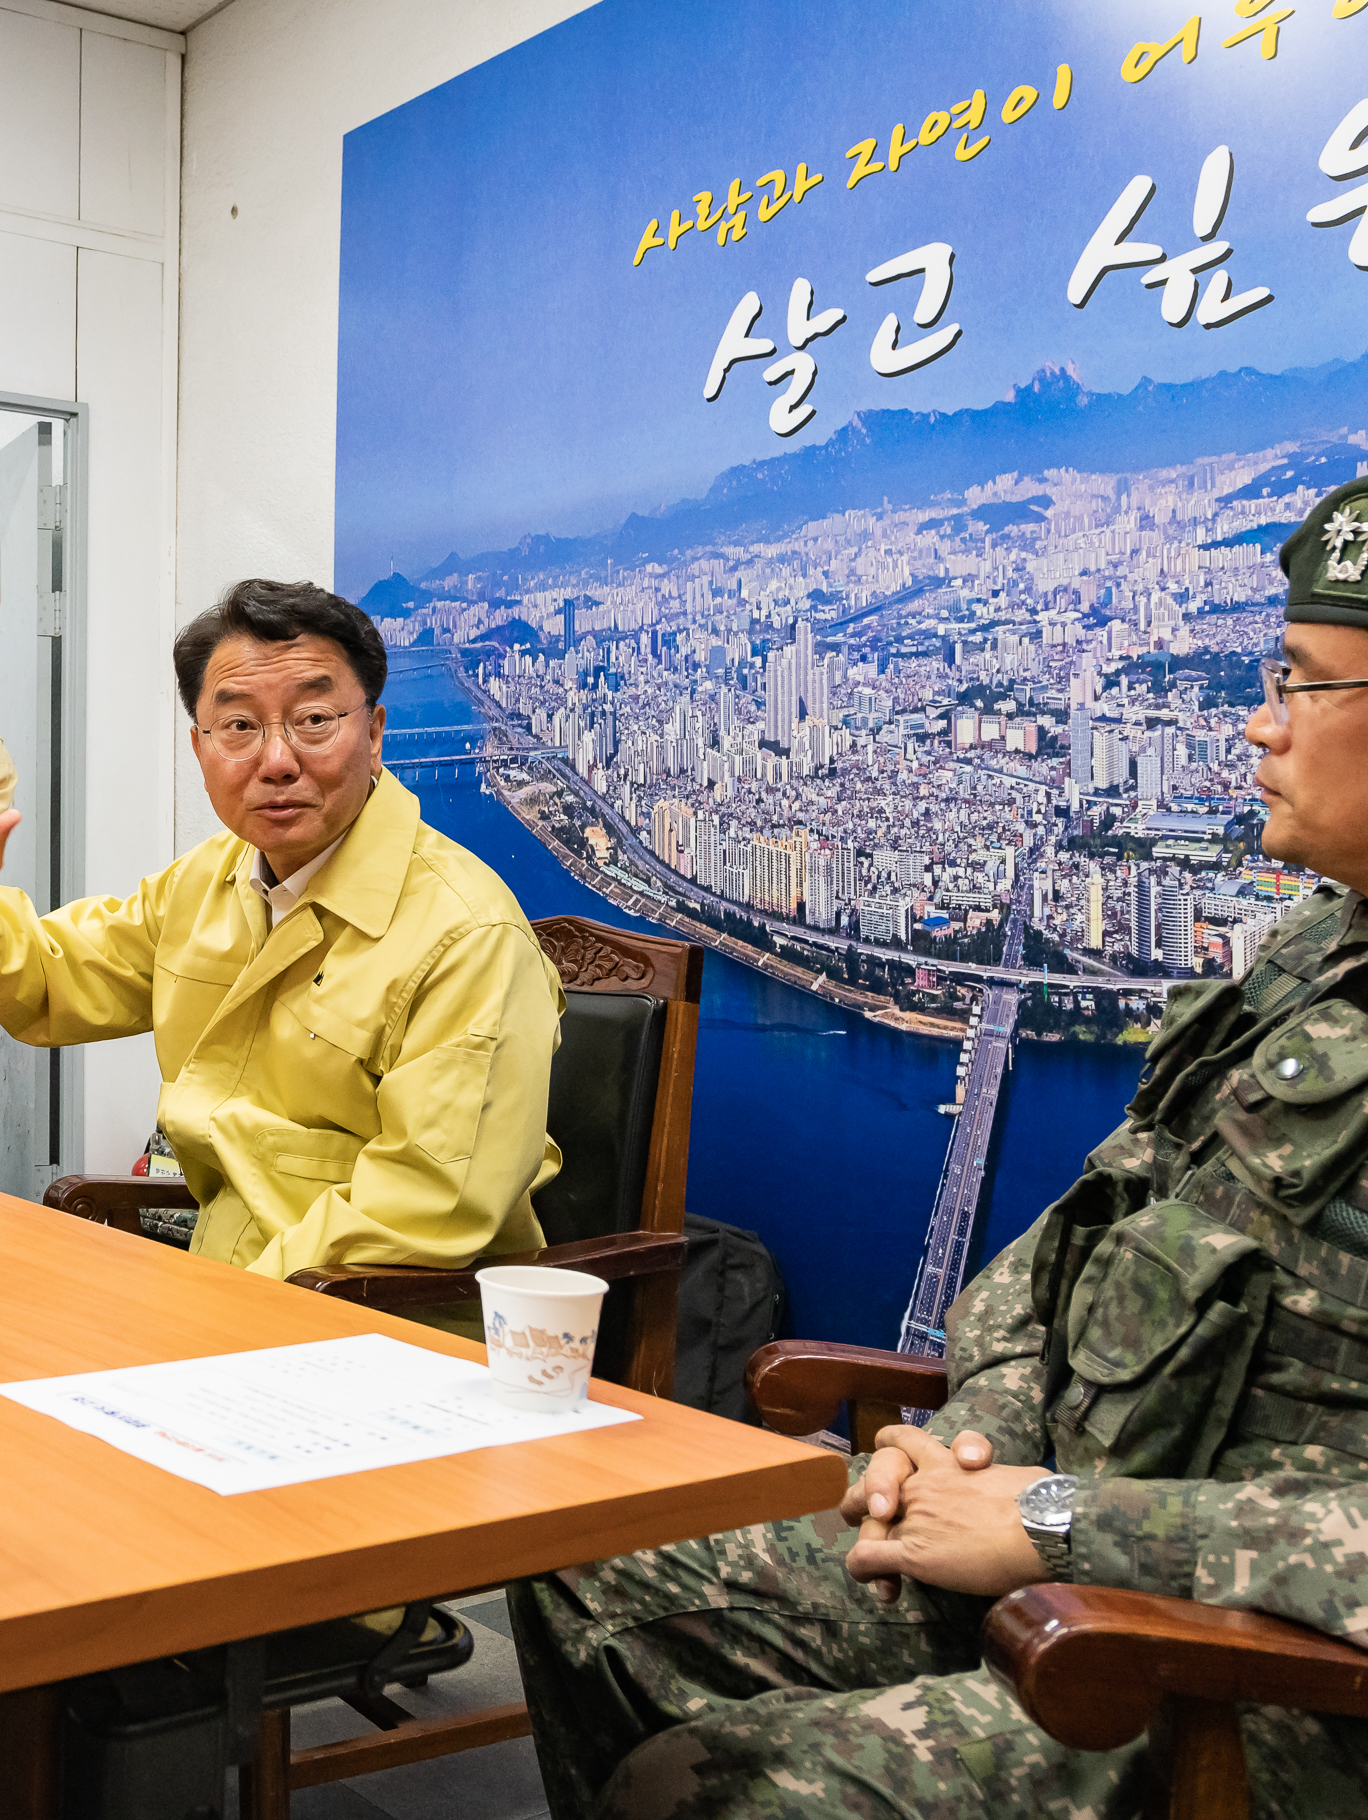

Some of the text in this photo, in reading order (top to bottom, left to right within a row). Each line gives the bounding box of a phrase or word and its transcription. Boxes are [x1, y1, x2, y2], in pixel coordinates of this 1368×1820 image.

[633, 0, 1368, 266] 사람과 자연이 어우
[703, 242, 962, 436] 살고
